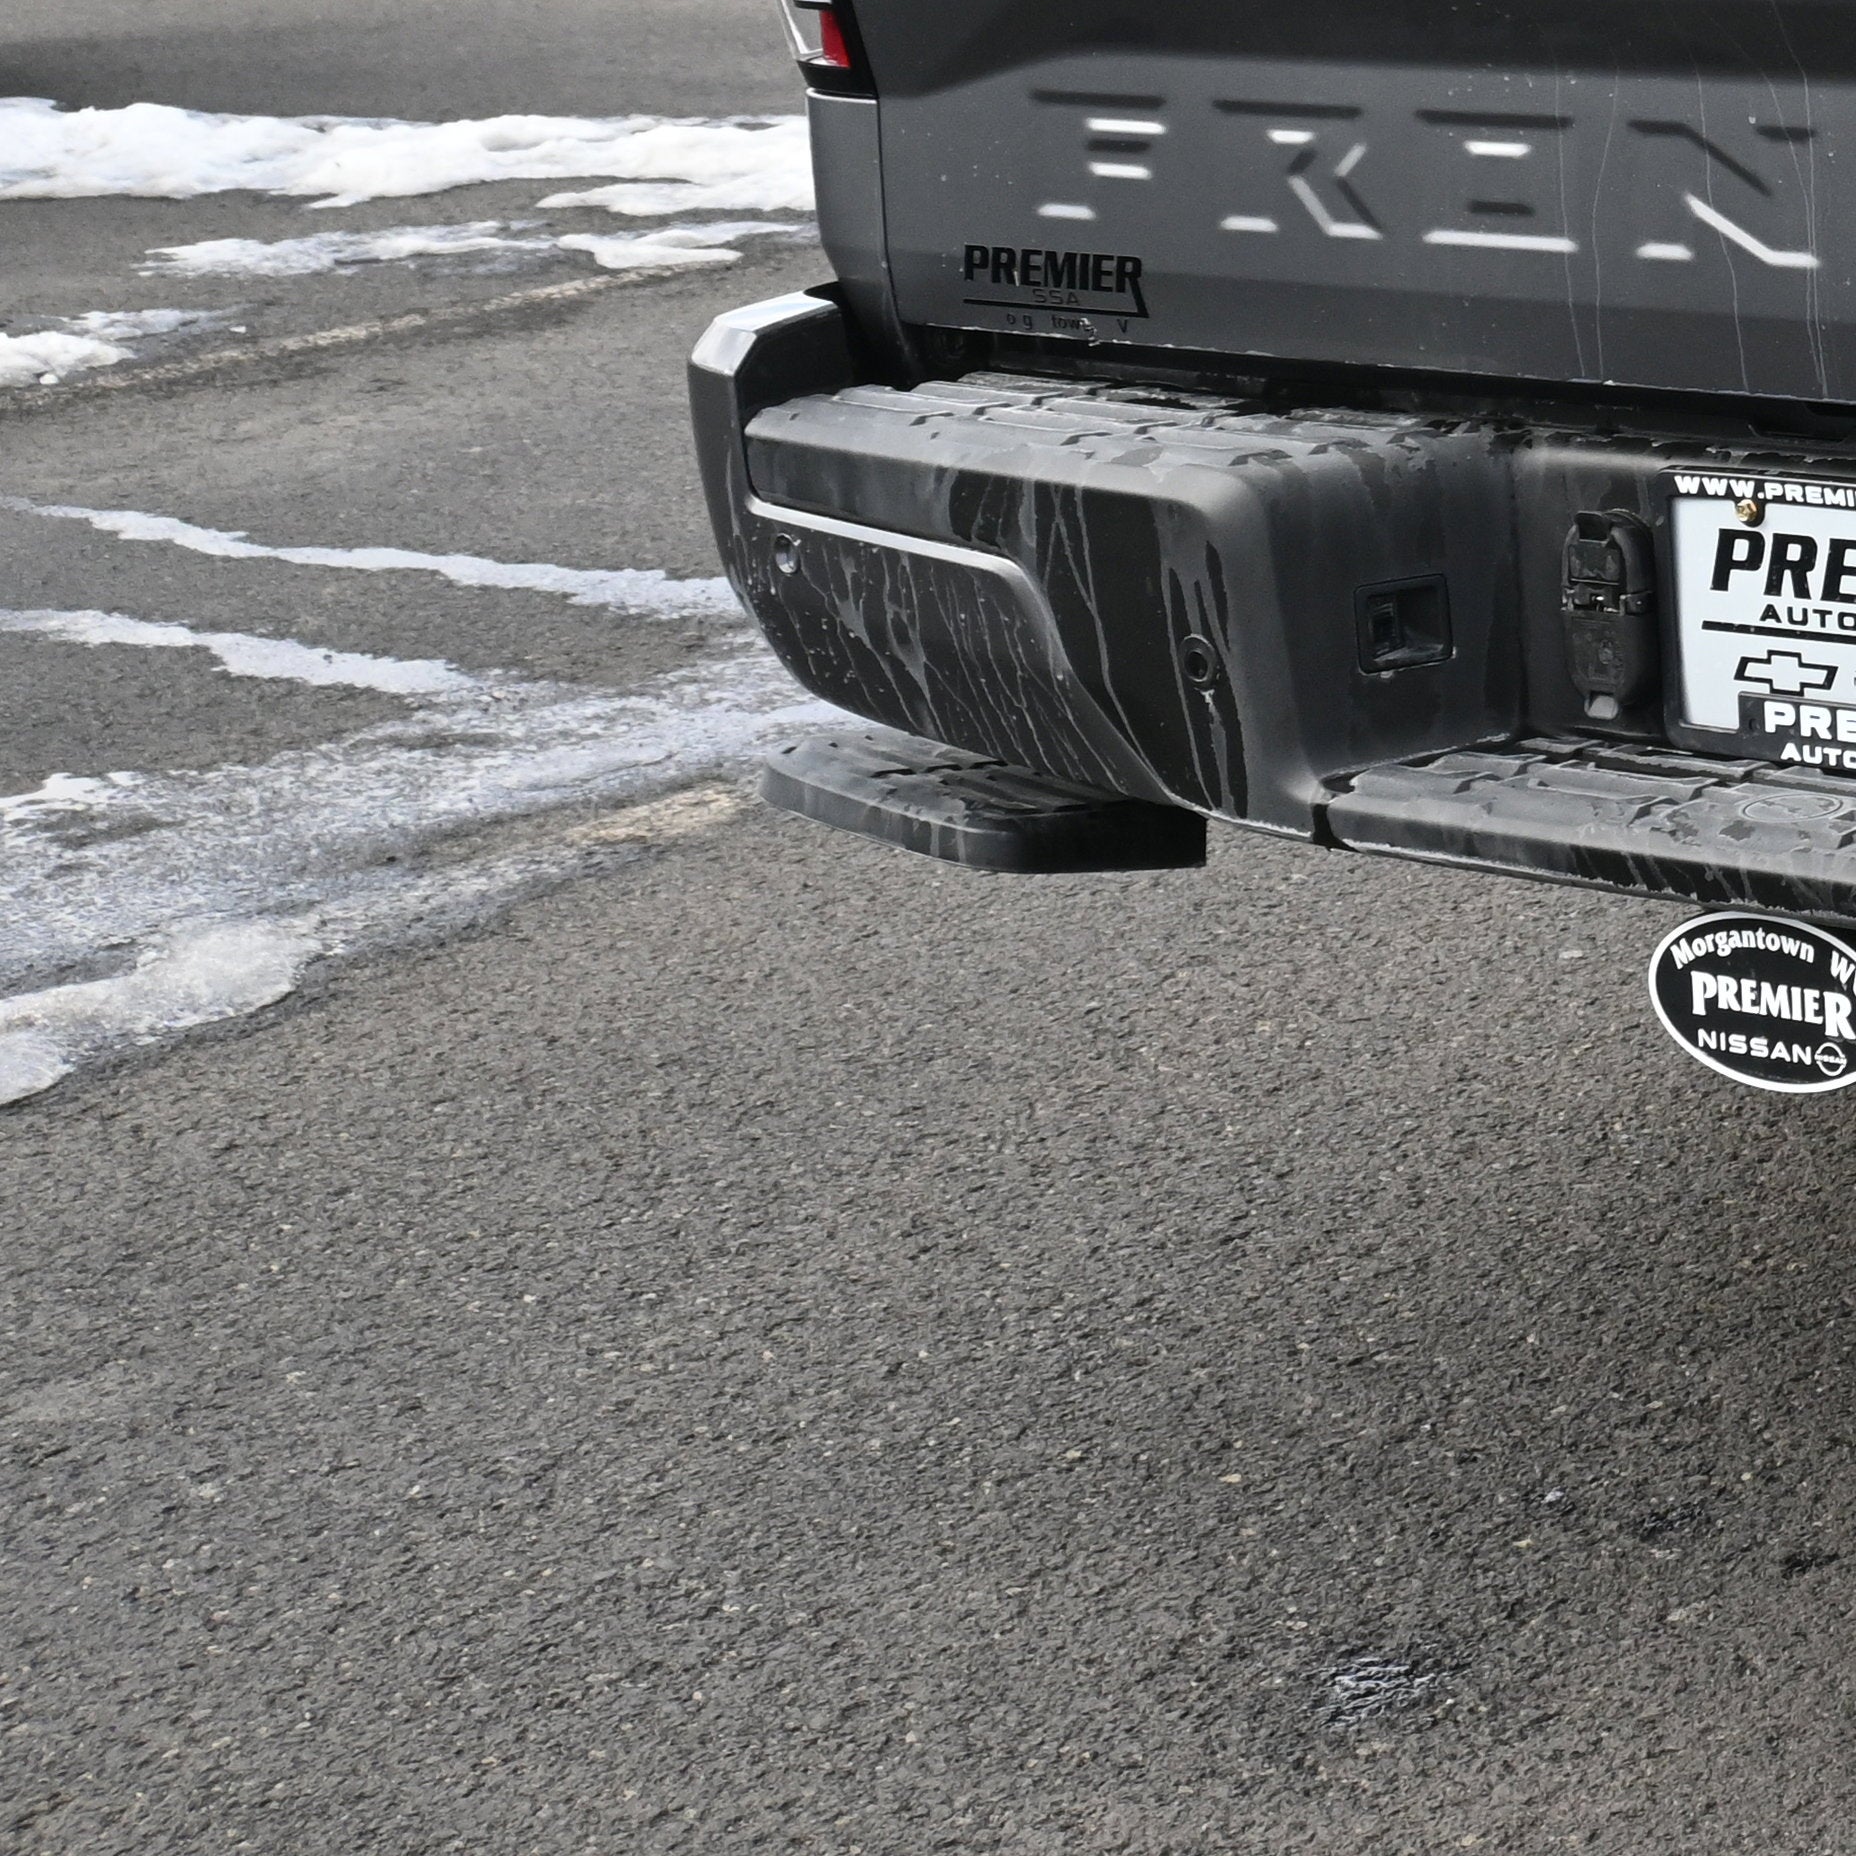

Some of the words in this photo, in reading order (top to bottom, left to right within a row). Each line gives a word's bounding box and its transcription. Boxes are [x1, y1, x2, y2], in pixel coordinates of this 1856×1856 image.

[964, 244, 1143, 294] PREMIER
[1670, 927, 1815, 970] Morgantown
[1697, 1028, 1812, 1066] NISSAN
